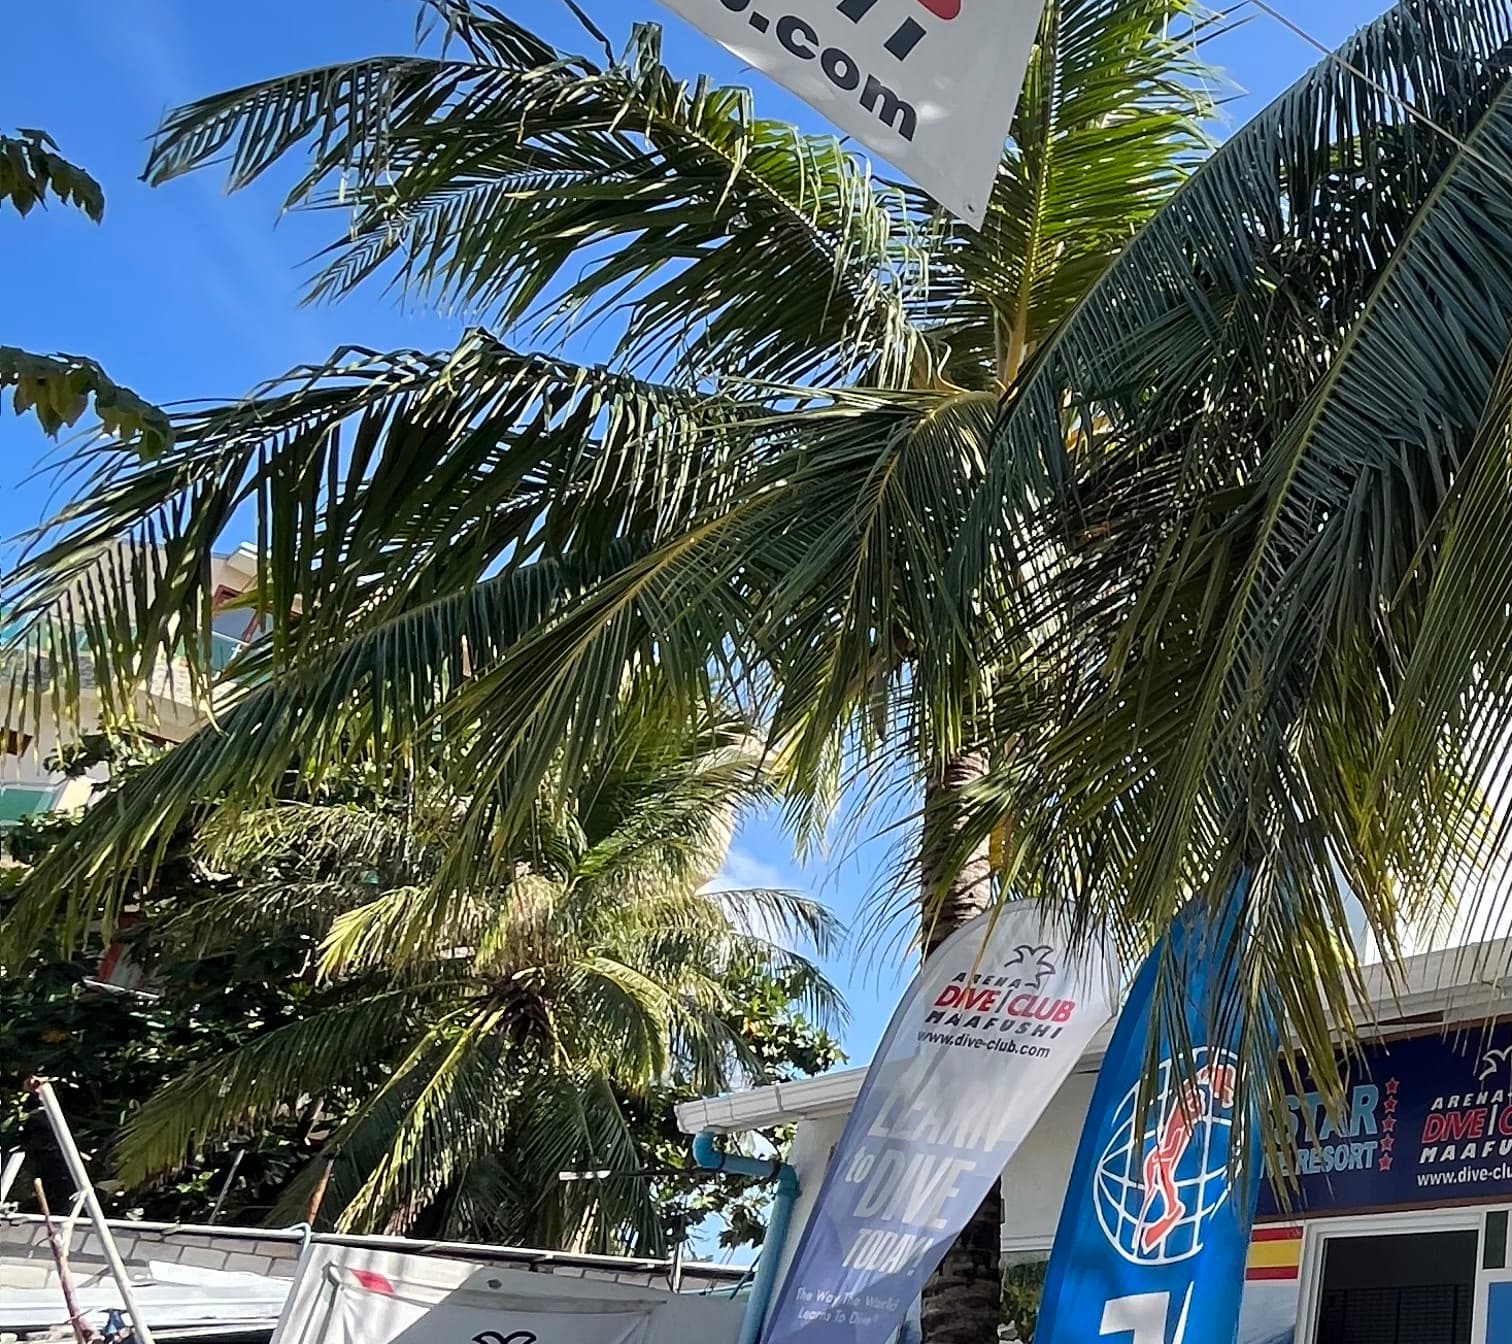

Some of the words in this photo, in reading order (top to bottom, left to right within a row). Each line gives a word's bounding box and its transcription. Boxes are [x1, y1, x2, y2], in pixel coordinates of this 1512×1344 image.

[1006, 992, 1077, 1023] CLUB
[924, 1009, 1064, 1040] MAAFUSHI
[1430, 1088, 1505, 1111] ARENA
[1420, 1107, 1489, 1144] DIVE
[1294, 1140, 1378, 1175] RESORT
[853, 1148, 977, 1230] DIVE
